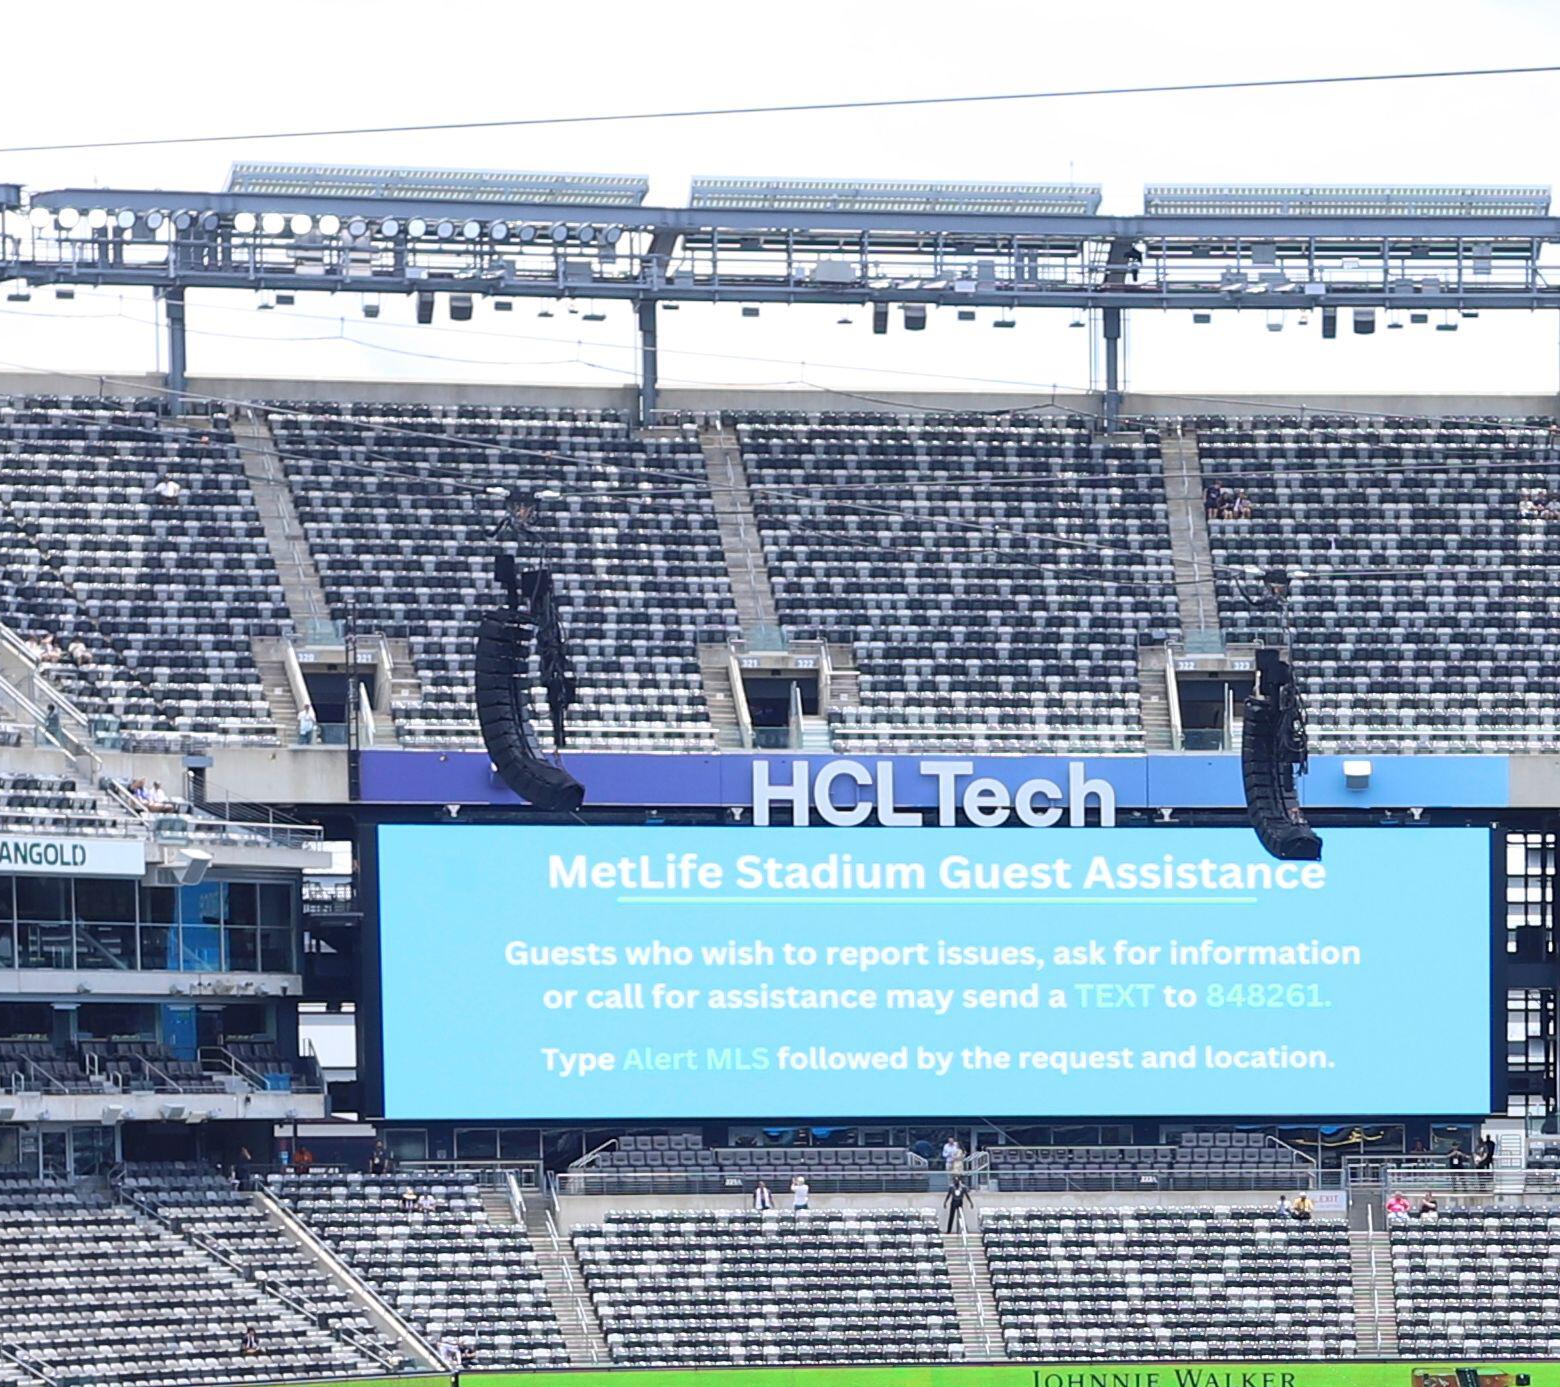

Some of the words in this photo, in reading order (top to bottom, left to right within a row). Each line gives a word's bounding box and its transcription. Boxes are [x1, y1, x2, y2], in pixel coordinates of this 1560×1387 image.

[753, 761, 1116, 828] HCLTech
[549, 853, 723, 889] MetLife
[736, 854, 925, 889] Stadium
[939, 855, 1072, 890] Guest
[1083, 854, 1327, 890] Assistance
[504, 940, 618, 966] Guests
[624, 939, 694, 966] who
[700, 939, 775, 966] wish
[782, 943, 818, 966] to
[826, 943, 930, 972] report
[937, 939, 1045, 971] issues,
[1052, 939, 1107, 966] ask
[1113, 939, 1162, 966] for
[1170, 938, 1361, 966] information
[542, 988, 579, 1010] or
[584, 982, 646, 1010] call
[650, 982, 702, 1010] for
[707, 982, 879, 1010] assistance
[885, 988, 956, 1016] may
[961, 982, 1041, 1009] send
[1047, 988, 1069, 1009] a
[1074, 983, 1156, 1008] TEXT
[1161, 984, 1199, 1009] to
[1207, 982, 1331, 1008] 848261.
[540, 1046, 618, 1078] Type
[623, 1048, 698, 1071] Alert
[706, 1047, 770, 1070] MLS
[775, 1044, 911, 1072] followed
[915, 1044, 956, 1077] by
[959, 1044, 1013, 1070] the
[1018, 1046, 1135, 1076] request
[1140, 1044, 1199, 1070] and
[1204, 1044, 1336, 1070] location.
